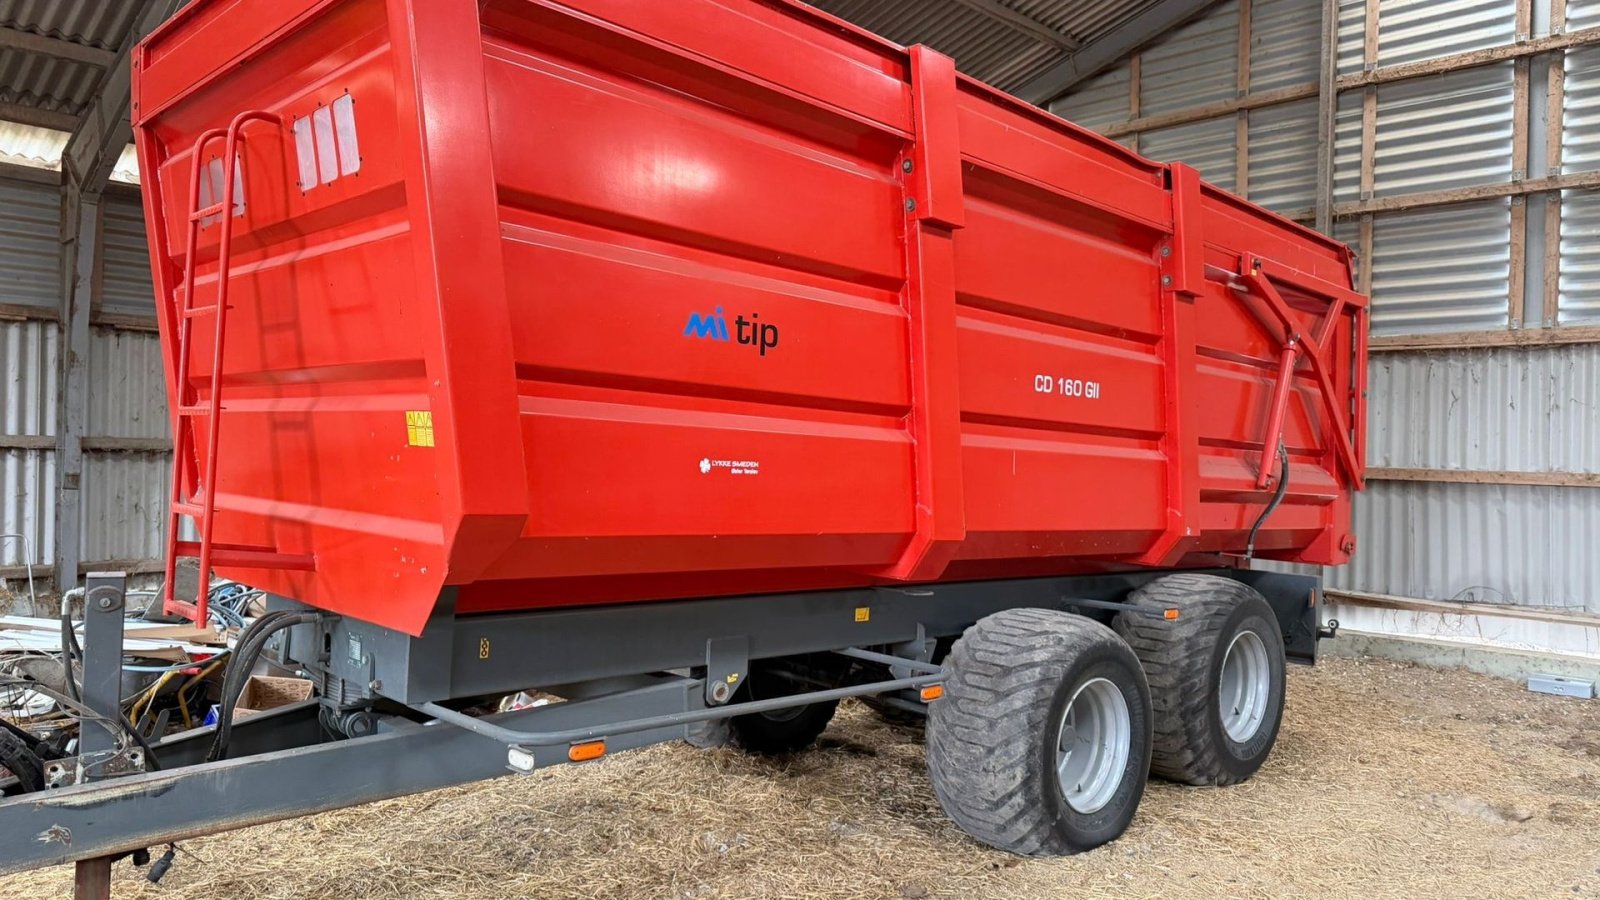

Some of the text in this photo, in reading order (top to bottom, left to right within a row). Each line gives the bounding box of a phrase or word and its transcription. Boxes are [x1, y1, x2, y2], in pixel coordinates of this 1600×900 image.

[735, 312, 778, 356] tip
[1035, 374, 1053, 393] CD
[1058, 377, 1082, 397] 160
